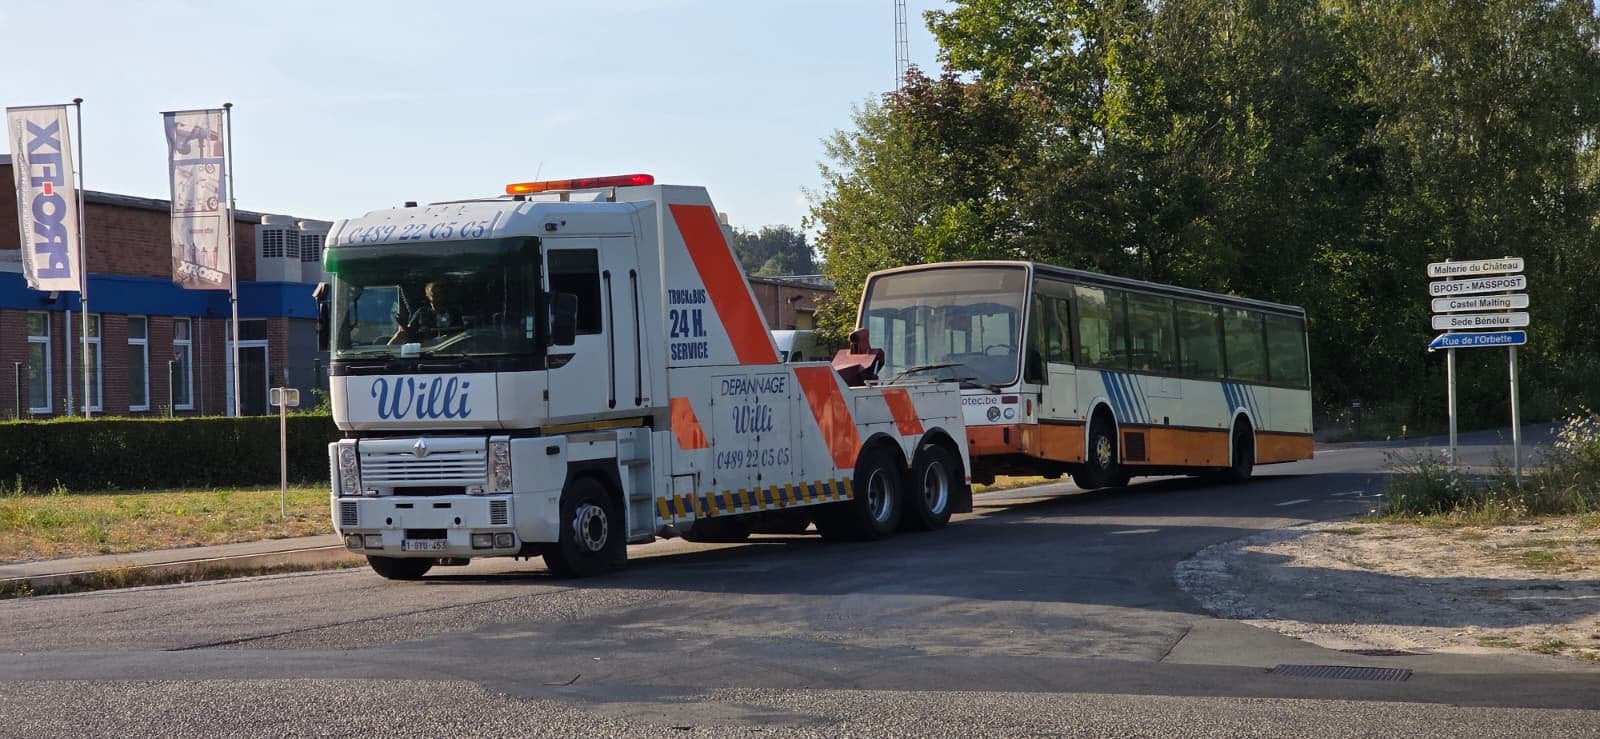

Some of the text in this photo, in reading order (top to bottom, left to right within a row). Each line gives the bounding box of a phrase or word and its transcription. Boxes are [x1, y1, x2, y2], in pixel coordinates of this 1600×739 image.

[348, 225, 396, 243] 0489
[399, 224, 427, 240] 22
[1434, 262, 1518, 273] Malterie du Château
[1434, 283, 1463, 292] BPOST
[1472, 279, 1522, 290] MASSPOST
[1450, 298, 1511, 308] Castel Malting
[669, 309, 707, 338] 24 H.
[1442, 335, 1512, 345] Rue de l'Orbette
[671, 341, 708, 360] SERVICE
[721, 377, 786, 396] DEPANNAGE
[371, 376, 472, 420] Willi
[962, 396, 998, 406] otec.be
[732, 404, 774, 434] Willi
[717, 450, 744, 470] 0489
[746, 449, 759, 468] 22
